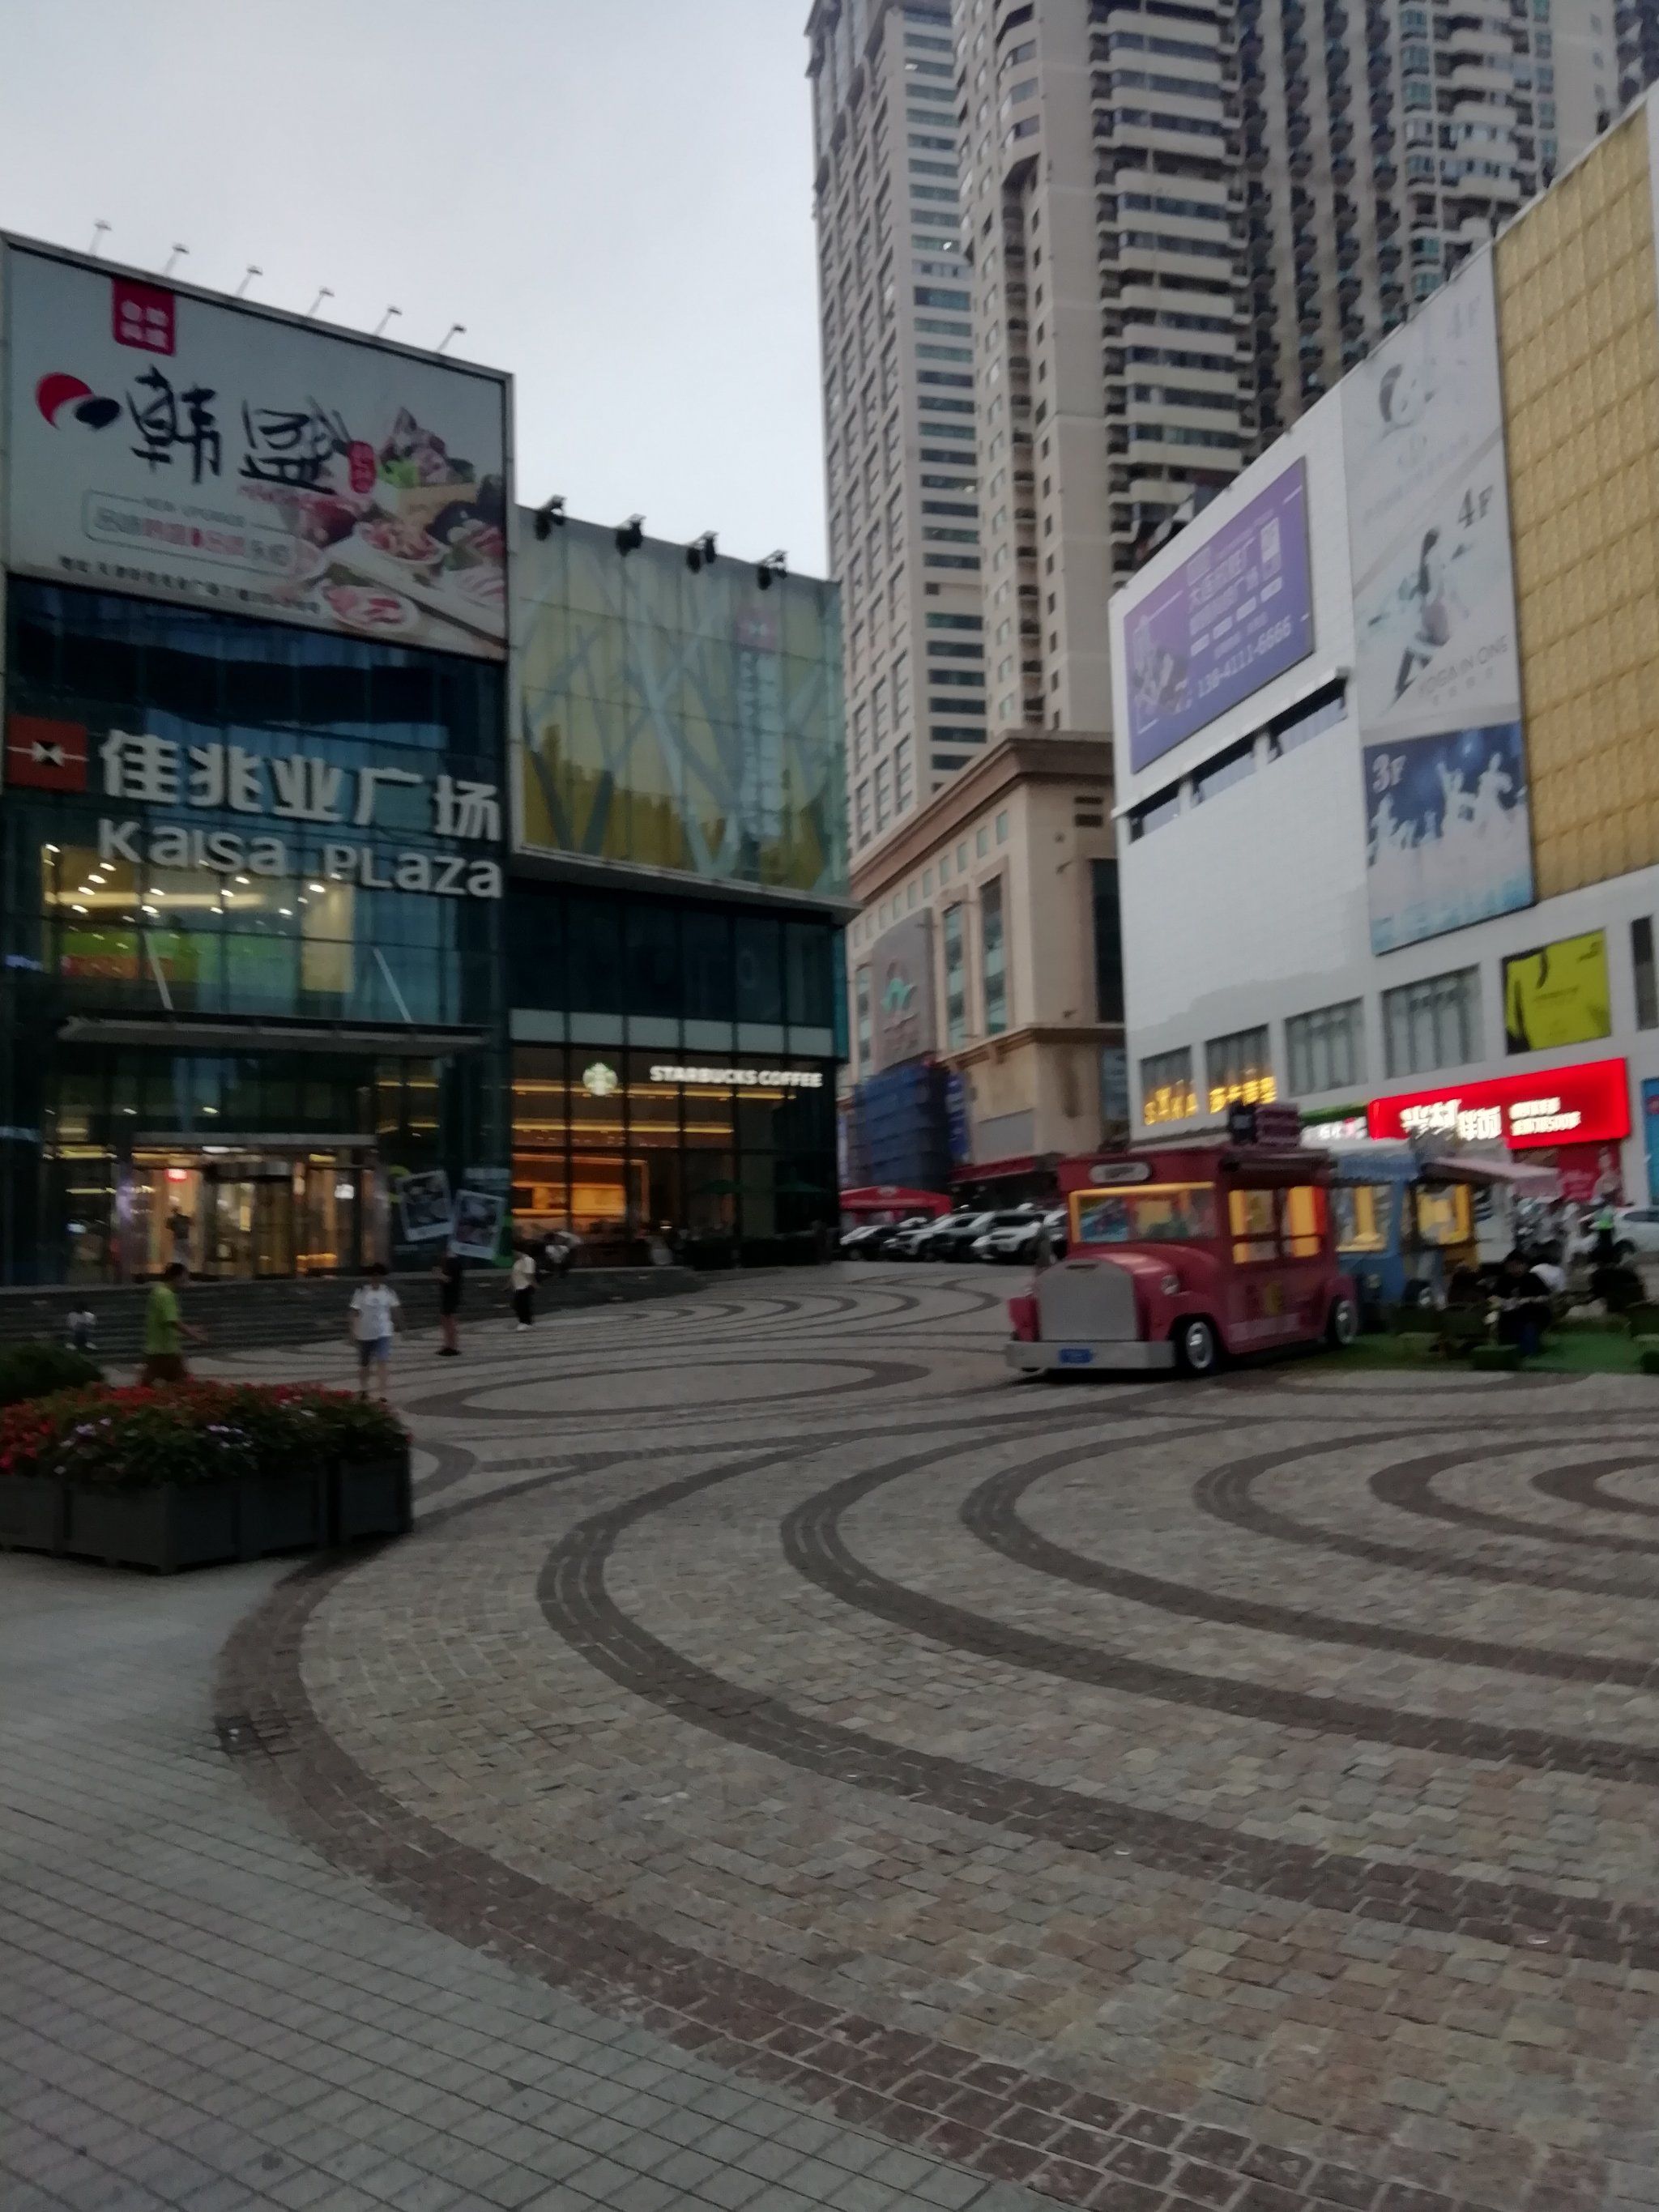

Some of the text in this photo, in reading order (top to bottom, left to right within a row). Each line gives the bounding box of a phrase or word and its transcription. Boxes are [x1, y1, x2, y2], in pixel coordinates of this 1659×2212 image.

[1459, 485, 1494, 530] 4F
[100, 728, 501, 842] 佳兆业广场
[1371, 753, 1407, 794] 3F
[650, 1065, 823, 1088] STARBUCKS COFFEE
